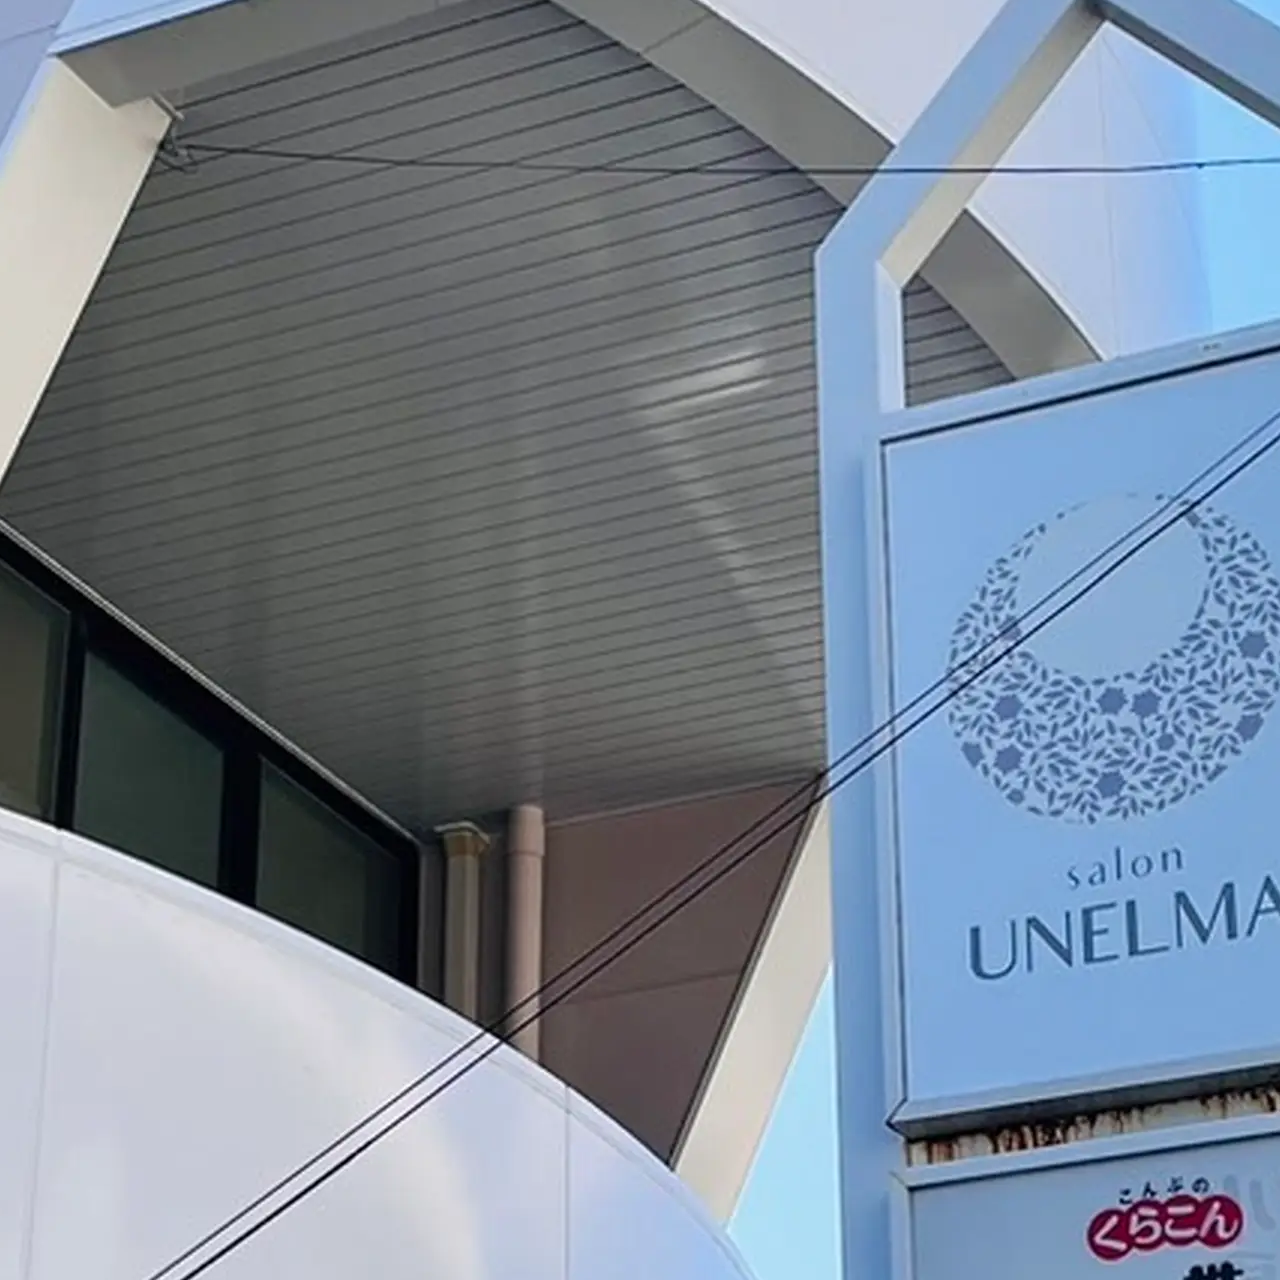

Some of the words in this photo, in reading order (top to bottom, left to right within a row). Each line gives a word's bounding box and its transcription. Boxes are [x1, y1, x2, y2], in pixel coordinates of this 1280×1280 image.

[1066, 845, 1185, 890] salon
[1118, 1175, 1211, 1205] こんぶの
[1093, 1200, 1240, 1253] くらこん
